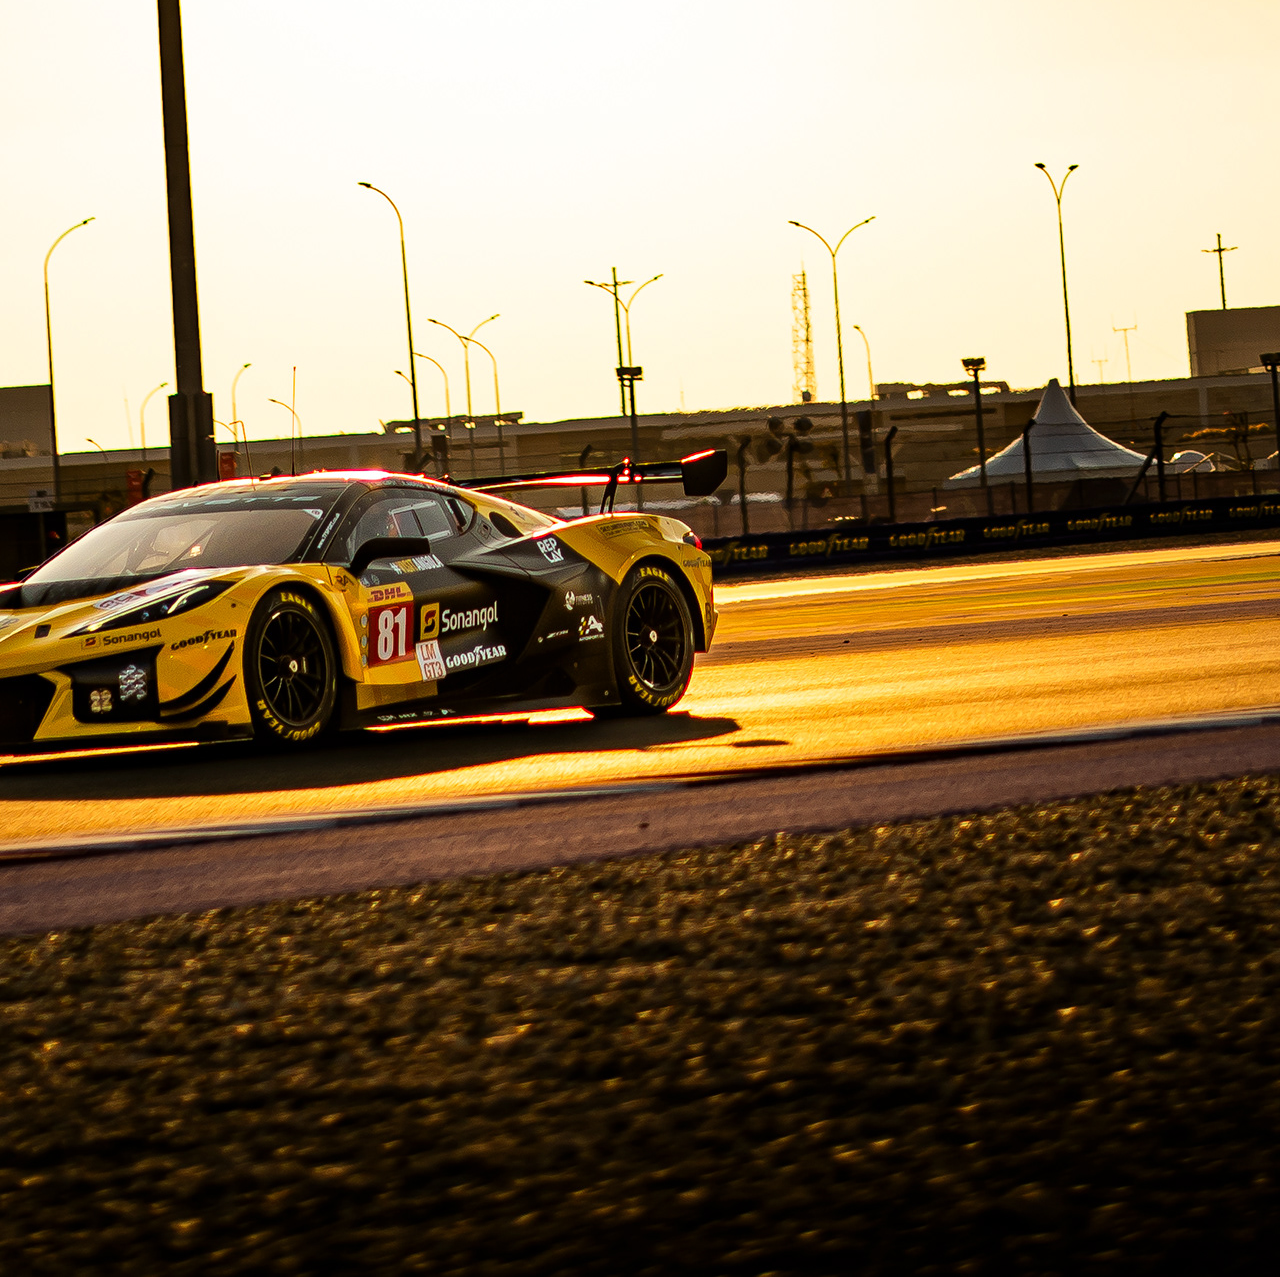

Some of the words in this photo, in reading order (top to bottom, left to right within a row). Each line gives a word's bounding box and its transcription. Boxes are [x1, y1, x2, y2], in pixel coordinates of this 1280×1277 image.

[1067, 512, 1133, 532] GOODYEAR
[1149, 505, 1213, 526] GOODYEAR
[888, 526, 966, 550] GOODYEAR
[983, 519, 1050, 540] GOODYEAR
[537, 537, 558, 553] REP
[543, 547, 565, 564] LAY
[788, 533, 869, 558] GOODYEAR
[280, 592, 314, 614] EAGLE
[371, 586, 407, 602] DHL
[441, 600, 499, 633] Sonangol
[102, 628, 162, 646] Sonangol
[170, 629, 237, 651] GOODYEAR
[377, 607, 407, 661] 81
[420, 644, 437, 661] LM
[445, 644, 507, 667] GOODYEAR
[423, 661, 443, 680] GT3
